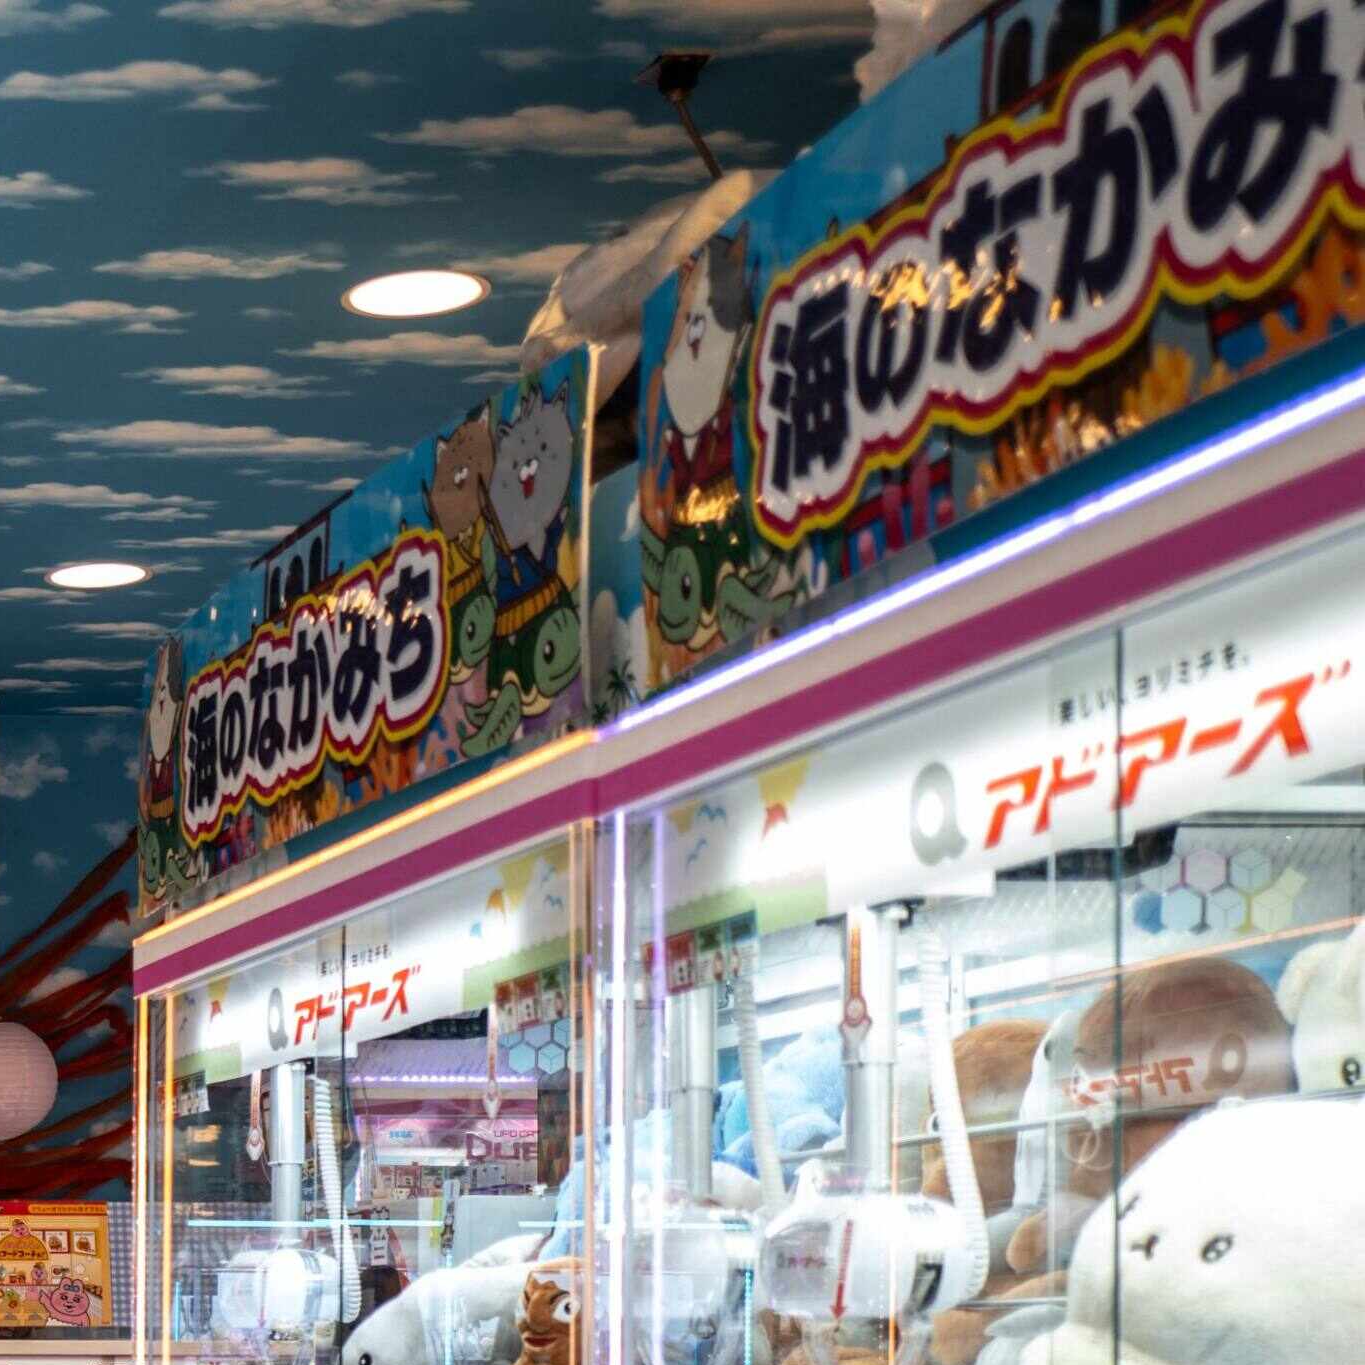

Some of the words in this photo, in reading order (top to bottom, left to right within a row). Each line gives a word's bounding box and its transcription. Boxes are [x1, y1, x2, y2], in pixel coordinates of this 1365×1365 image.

[769, 4, 1365, 492] 海のなかみ
[188, 566, 433, 814] 海のなかみち
[984, 660, 1351, 850] アドアーズ
[294, 964, 421, 1046] アドアーズ
